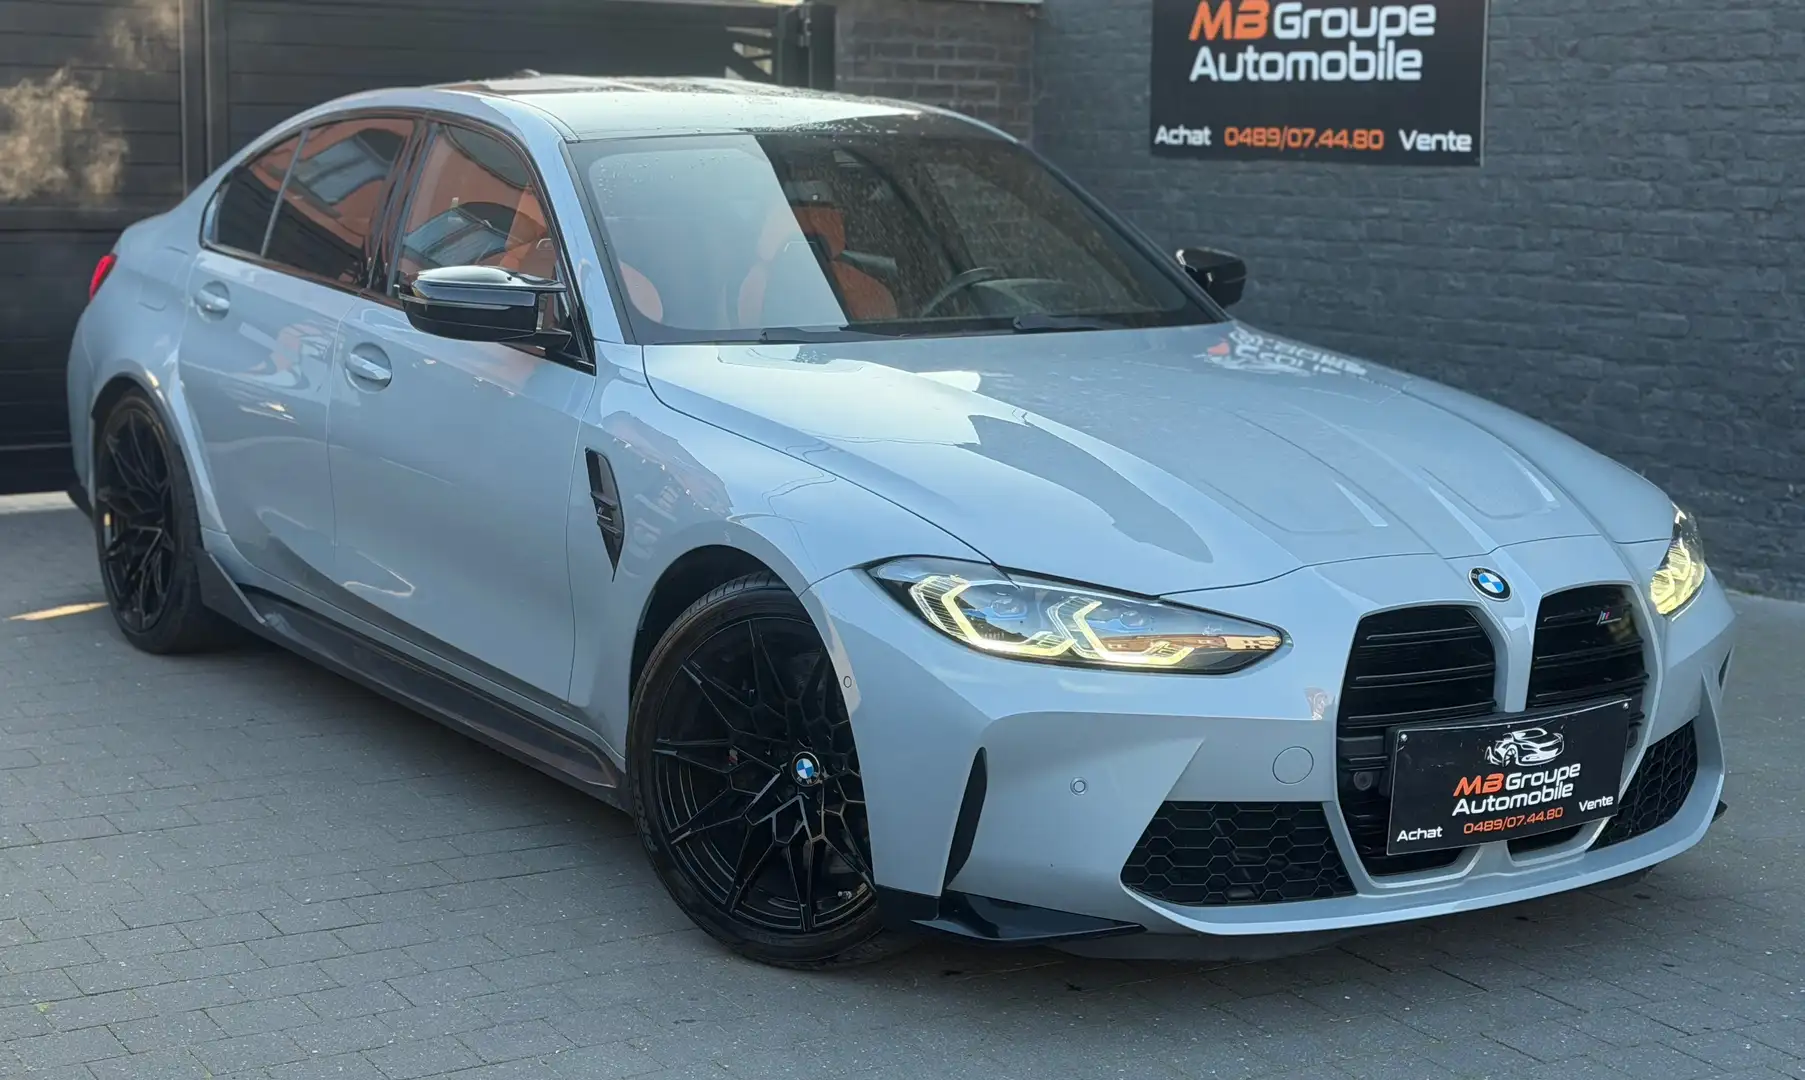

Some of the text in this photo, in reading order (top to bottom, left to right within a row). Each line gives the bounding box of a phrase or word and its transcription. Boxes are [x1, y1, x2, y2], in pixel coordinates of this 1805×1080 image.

[1188, 0, 1437, 48] MB Groupe
[1189, 40, 1423, 82] Automobile
[1154, 124, 1473, 153] Achat 0489/07.44.80 Vente
[1451, 781, 1575, 817] Automobile
[1452, 763, 1582, 797] MB Groupe
[1396, 794, 1614, 843] Achat 0489/07.44.80 Vente
